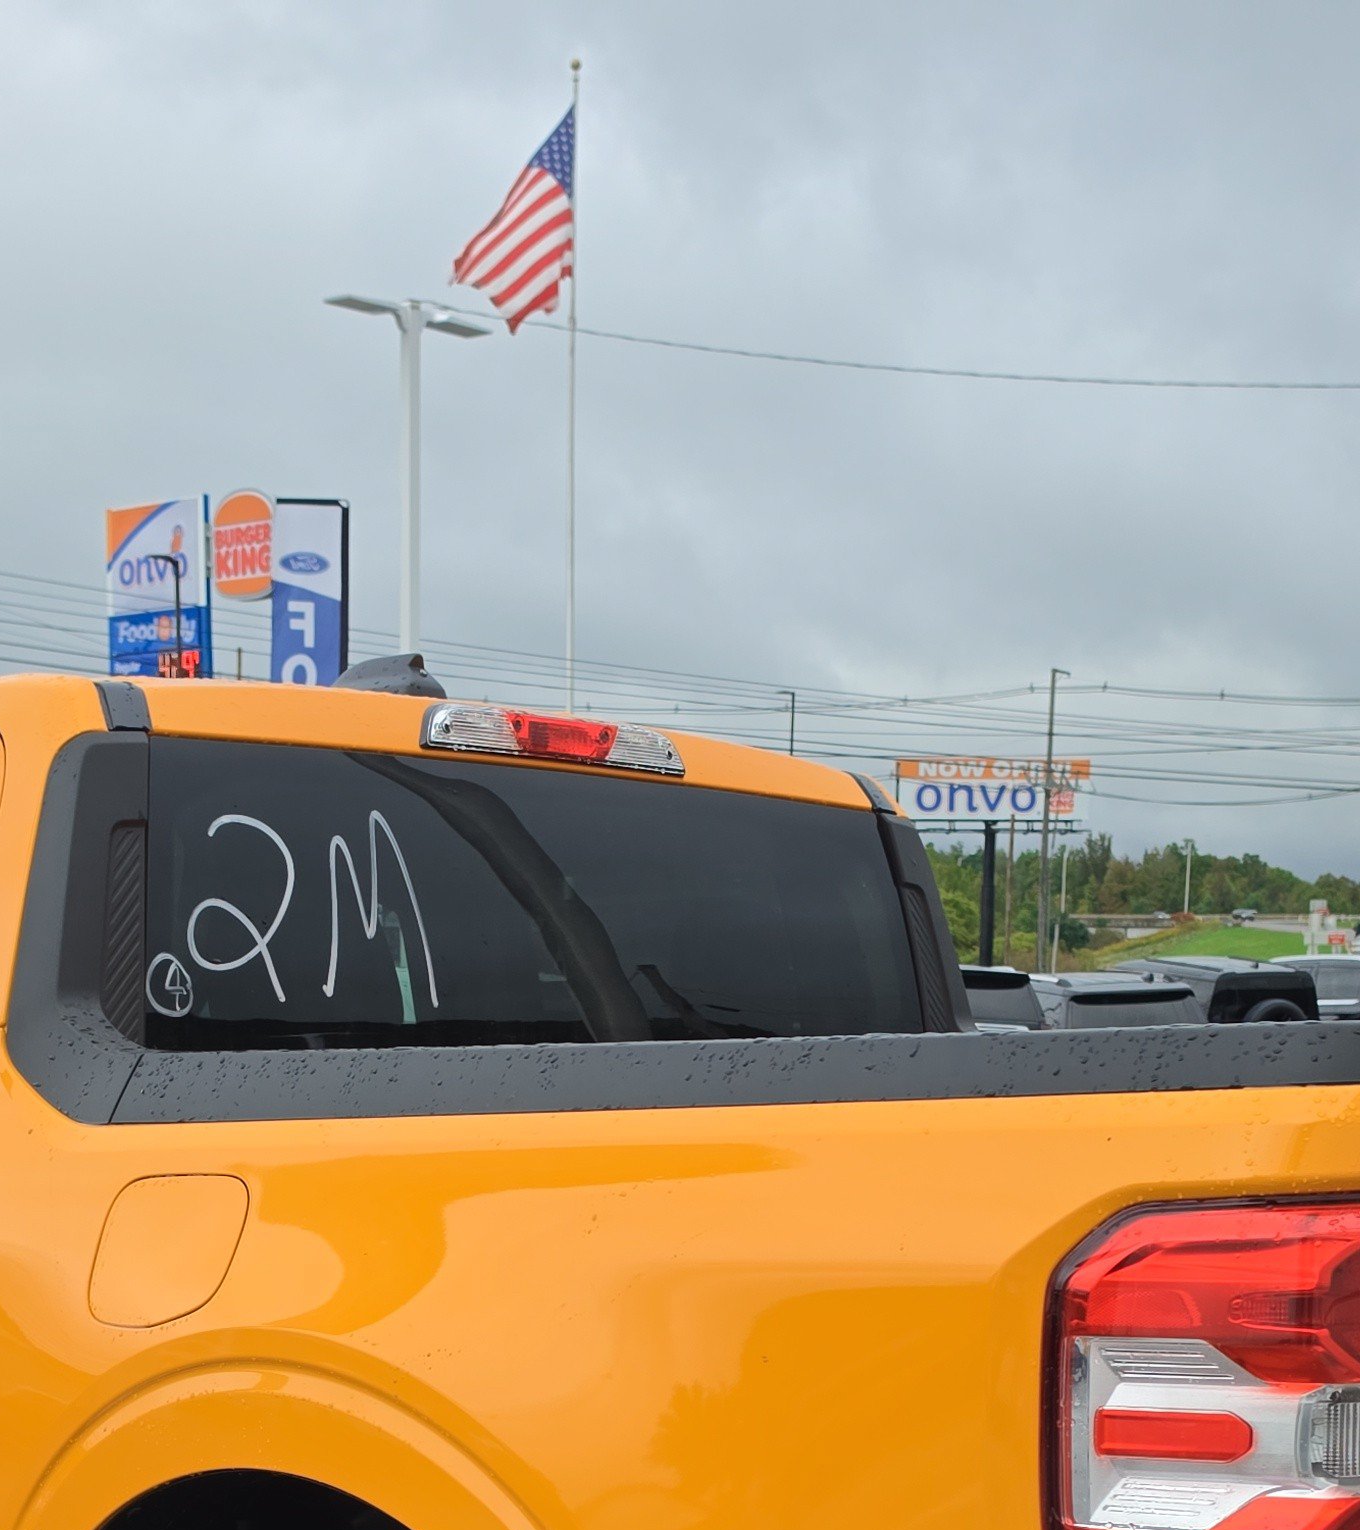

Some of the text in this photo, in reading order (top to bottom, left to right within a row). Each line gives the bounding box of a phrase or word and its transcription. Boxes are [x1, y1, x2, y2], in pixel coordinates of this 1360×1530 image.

[215, 523, 271, 550] BURGER
[118, 551, 188, 587] onvo
[216, 545, 271, 579] KING
[917, 758, 987, 778] NOW
[916, 783, 1037, 813] onvo
